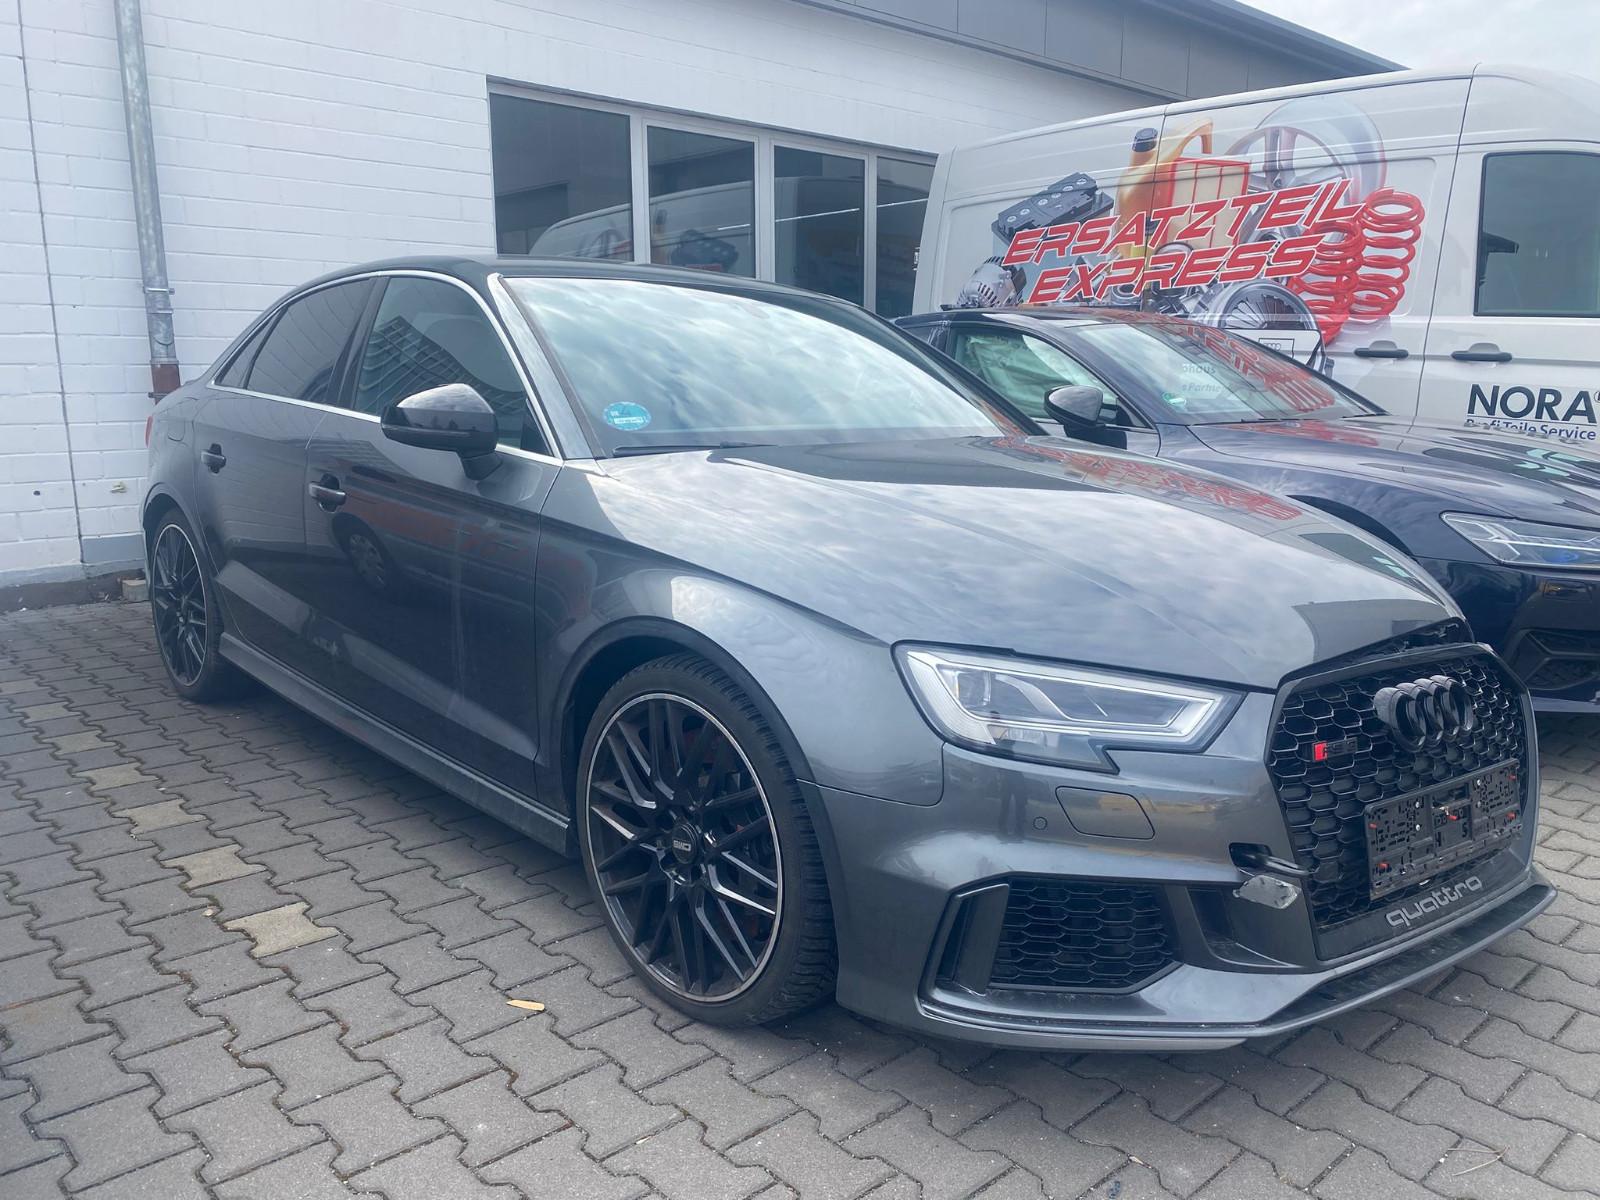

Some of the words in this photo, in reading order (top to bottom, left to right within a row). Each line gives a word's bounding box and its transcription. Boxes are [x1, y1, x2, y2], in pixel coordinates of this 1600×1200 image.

[1002, 177, 1366, 266] ERSATZTEIL
[1028, 234, 1327, 305] EXPRESS
[1540, 424, 1596, 441] Service
[1385, 876, 1482, 927] quattro
